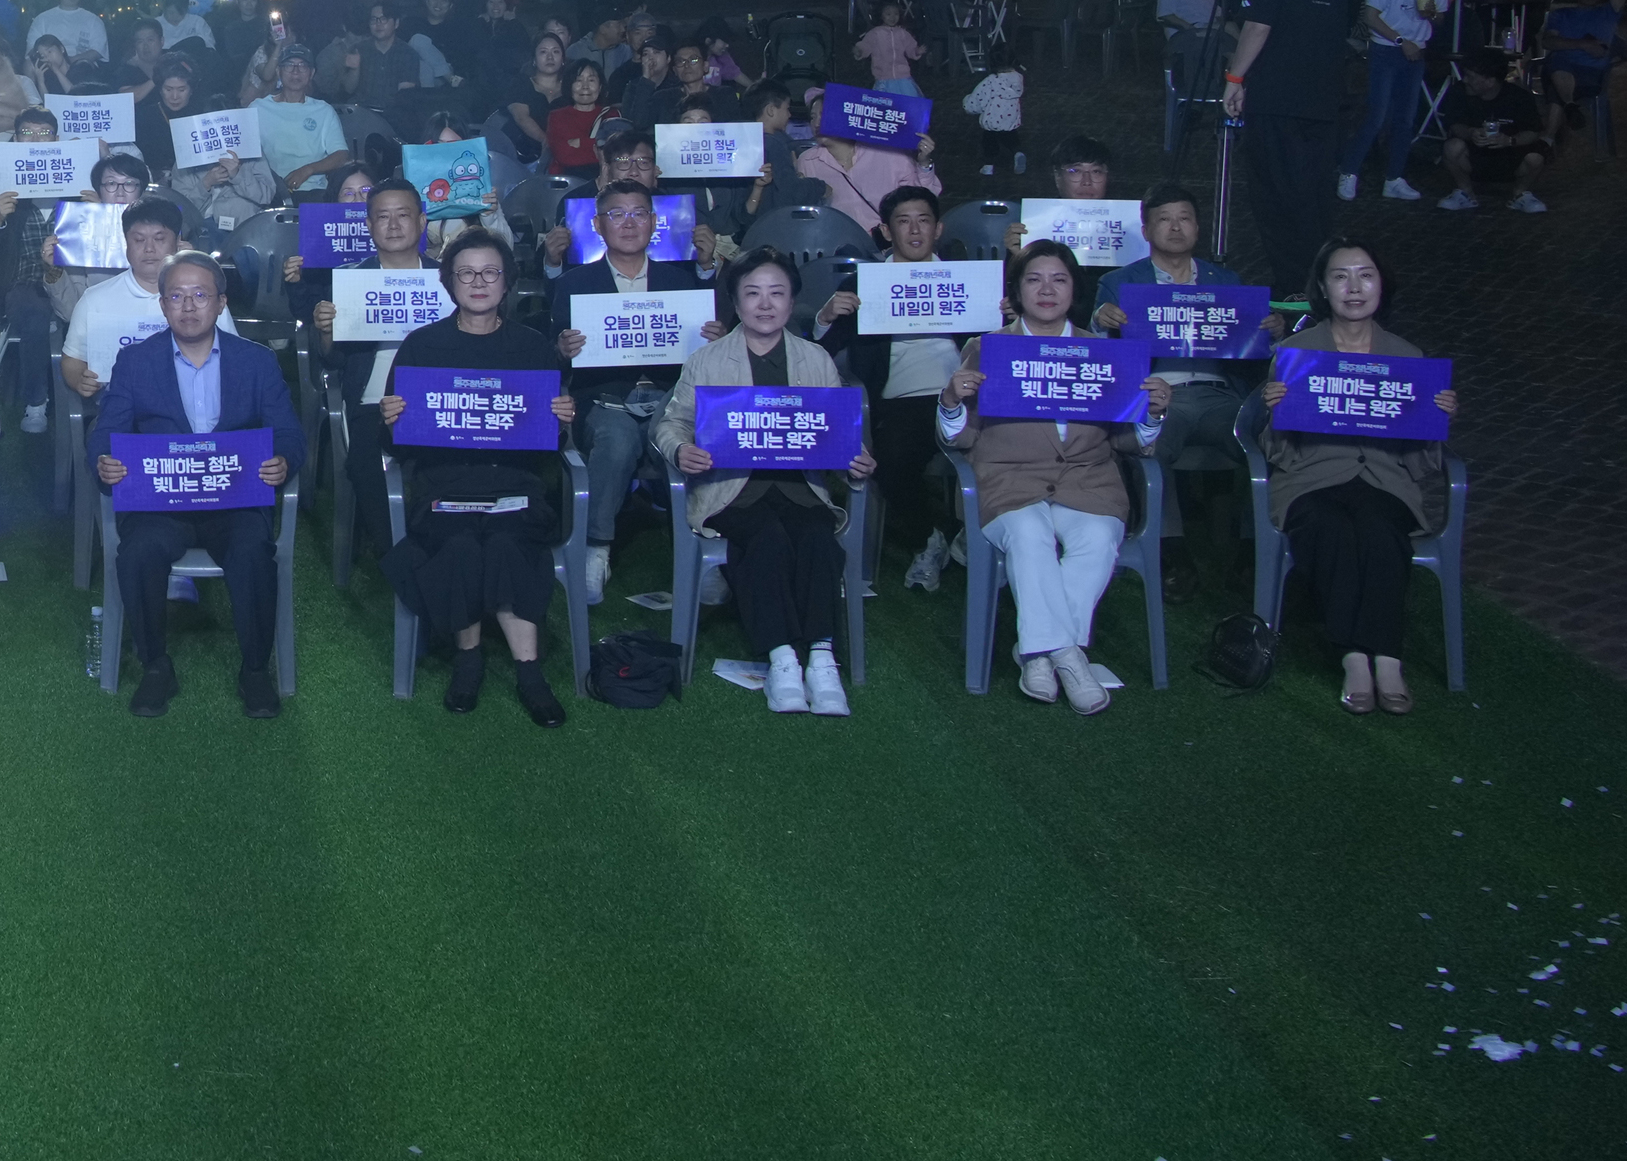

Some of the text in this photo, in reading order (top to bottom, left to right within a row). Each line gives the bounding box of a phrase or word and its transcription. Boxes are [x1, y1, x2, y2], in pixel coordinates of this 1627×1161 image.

[62, 110, 113, 121] 오늘의 청년,
[843, 102, 906, 124] 함께하는 청년,
[63, 121, 111, 133] 내일의 원주
[190, 124, 241, 142] 오늘의 청년,
[848, 115, 898, 134] 빛나는 원주
[193, 136, 241, 156] 내일의 원주
[680, 139, 735, 151] 오늘의 청년,
[15, 158, 75, 171] 오늘의 청년,
[681, 152, 733, 165] 내일의 원주
[15, 172, 73, 185] 내일의 원주
[324, 222, 370, 236] 함께하는
[1096, 220, 1126, 236] 청년,
[332, 238, 367, 252] 빛나는
[1097, 236, 1124, 250] 원주
[365, 291, 442, 307] 오늘의 청년,
[891, 283, 969, 299] 오늘의 청년,
[366, 309, 439, 323] 내일의 원주
[892, 301, 966, 316] 내일의 원주
[1147, 306, 1238, 324] 함께하는 청년,
[604, 314, 682, 331] 오늘의 청년,
[605, 331, 679, 349] 내일의 원주
[1156, 324, 1227, 340] 빛나는 원주
[1012, 360, 1115, 383] 함께하는 청년,
[1021, 381, 1102, 400] 빛나는 원주
[1309, 376, 1415, 401] 함께하는 청년,
[426, 392, 527, 413] 함께하는 청년,
[1318, 396, 1401, 417] 빛나는 원주
[436, 412, 514, 429] 빛나는 원주
[727, 412, 829, 431] 함께하는 청년,
[737, 432, 816, 449] 빛나는 원주
[143, 455, 242, 474] 함께하는 청년,
[153, 474, 230, 492] 빛나는 원주
